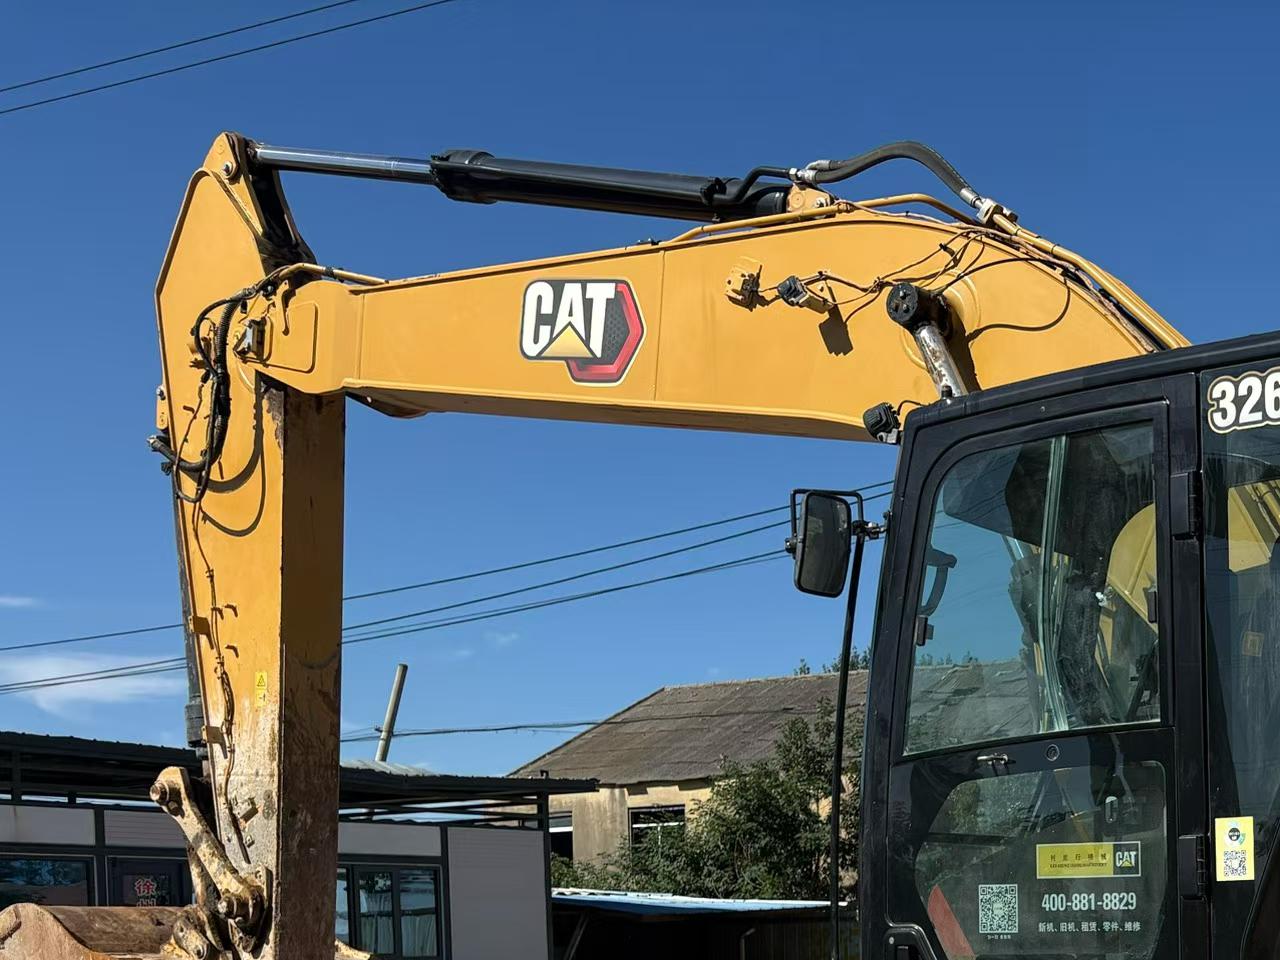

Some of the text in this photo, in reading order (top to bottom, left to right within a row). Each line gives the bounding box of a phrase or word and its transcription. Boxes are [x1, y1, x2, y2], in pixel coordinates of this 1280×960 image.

[523, 281, 616, 358] CAT
[1115, 851, 1137, 867] CAT
[1041, 892, 1137, 911] 400-881-8829
